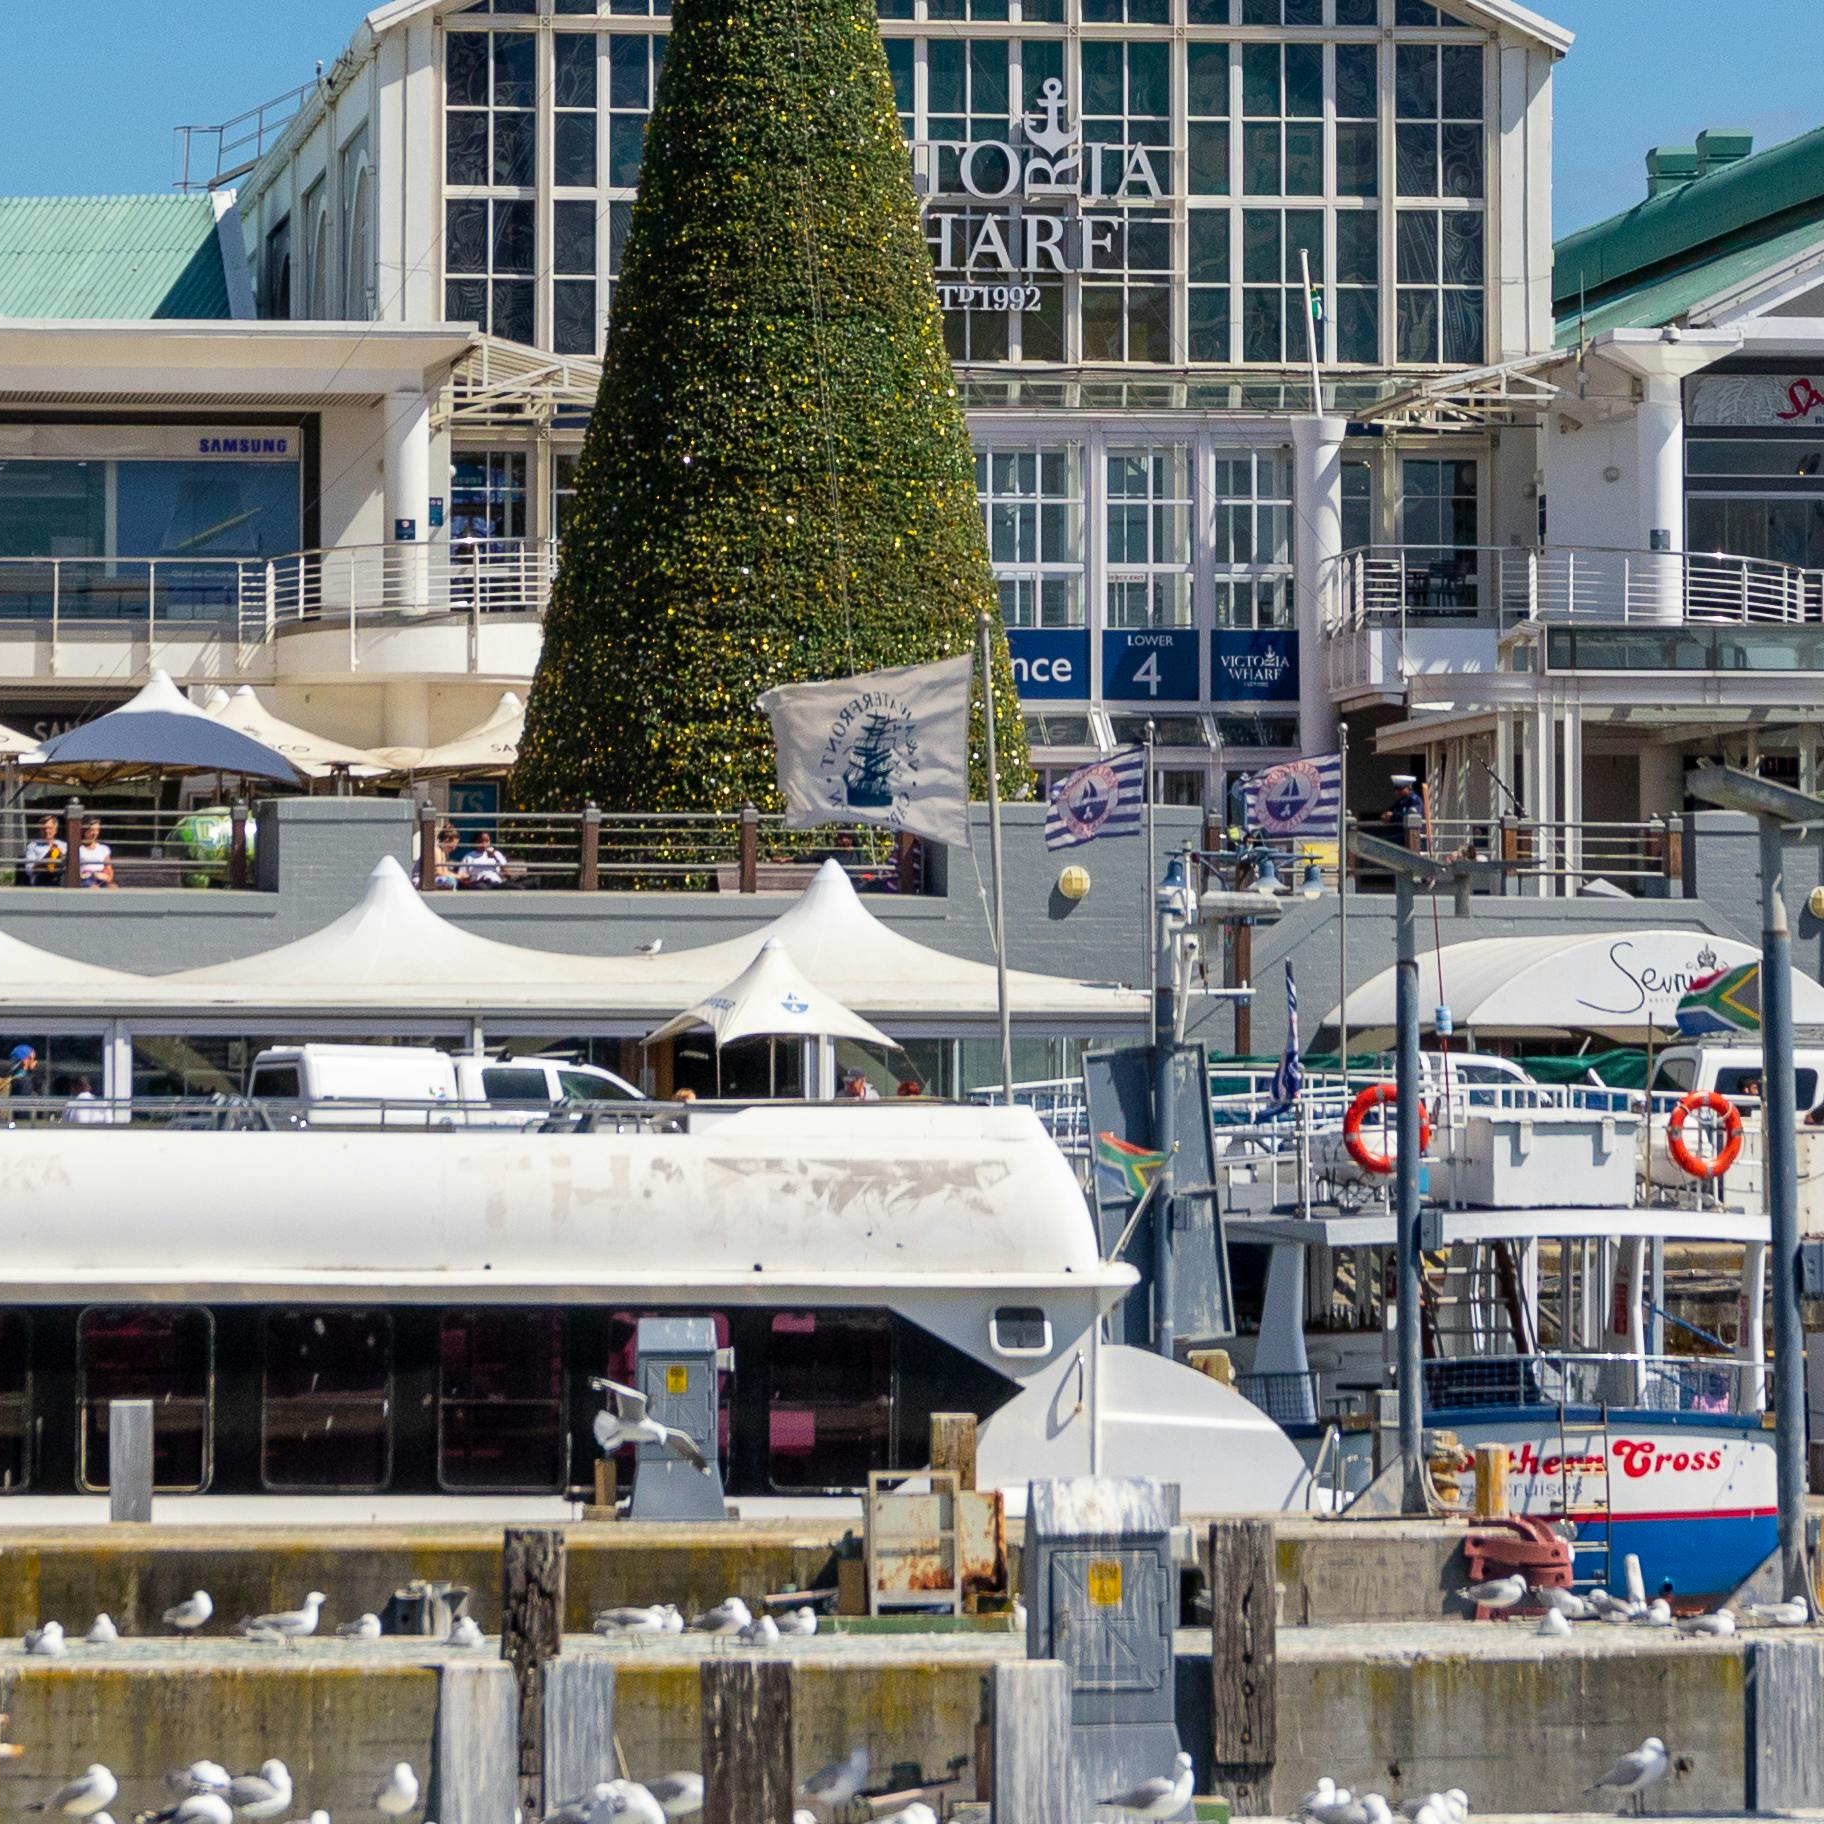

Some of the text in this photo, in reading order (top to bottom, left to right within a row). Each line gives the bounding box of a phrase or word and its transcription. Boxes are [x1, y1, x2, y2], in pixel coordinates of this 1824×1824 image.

[908, 136, 1163, 200] TORIA
[926, 213, 1119, 273] HARF
[199, 438, 287, 453] SAMSUNG
[1127, 635, 1174, 647] LOWER
[1010, 657, 1072, 682] nce
[1133, 651, 1162, 696] 4
[1228, 668, 1282, 681] WHARF
[490, 743, 515, 753] SA
[1576, 941, 1694, 1014] Sevru
[1612, 1439, 1722, 1479] Cross
